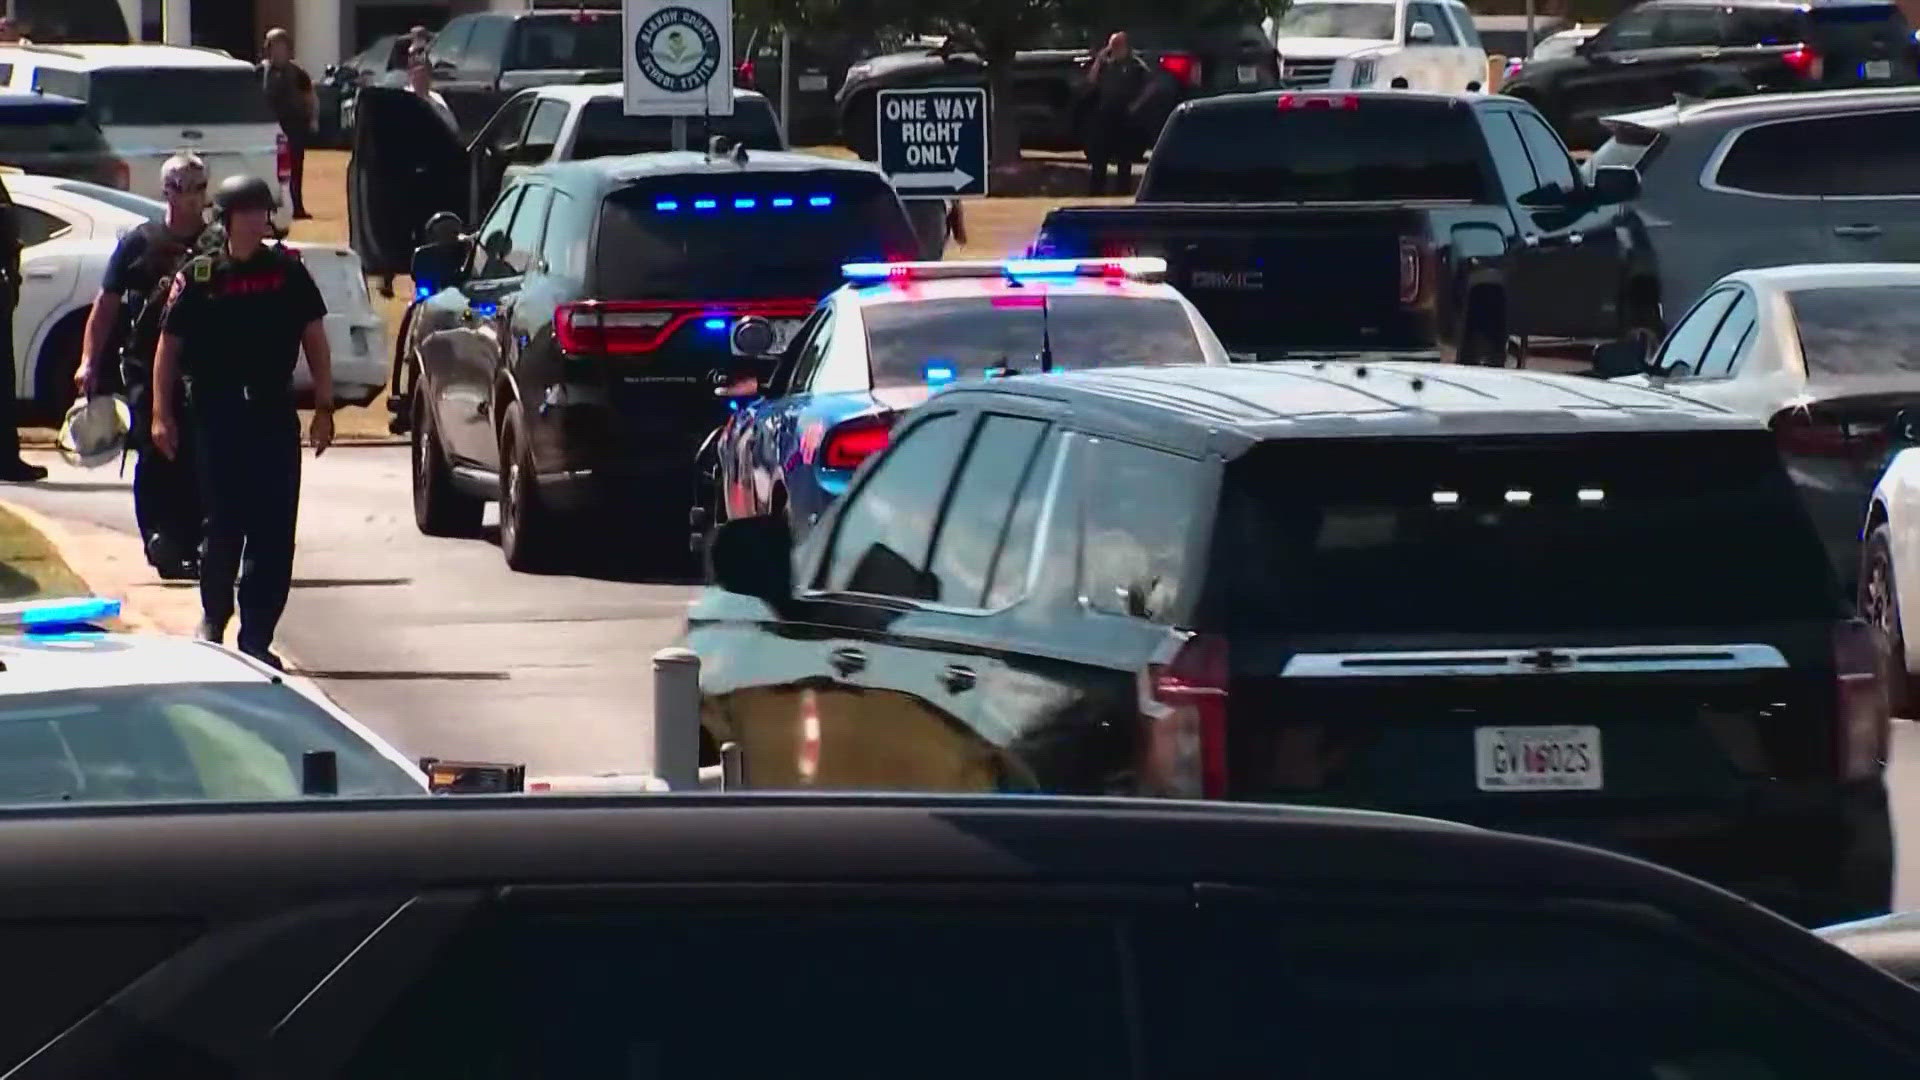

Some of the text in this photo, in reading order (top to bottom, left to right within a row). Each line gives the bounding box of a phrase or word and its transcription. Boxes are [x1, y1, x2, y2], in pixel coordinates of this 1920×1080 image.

[886, 98, 977, 120] ONE WAY
[902, 122, 962, 143] RIGHT
[906, 144, 959, 165] ONLY
